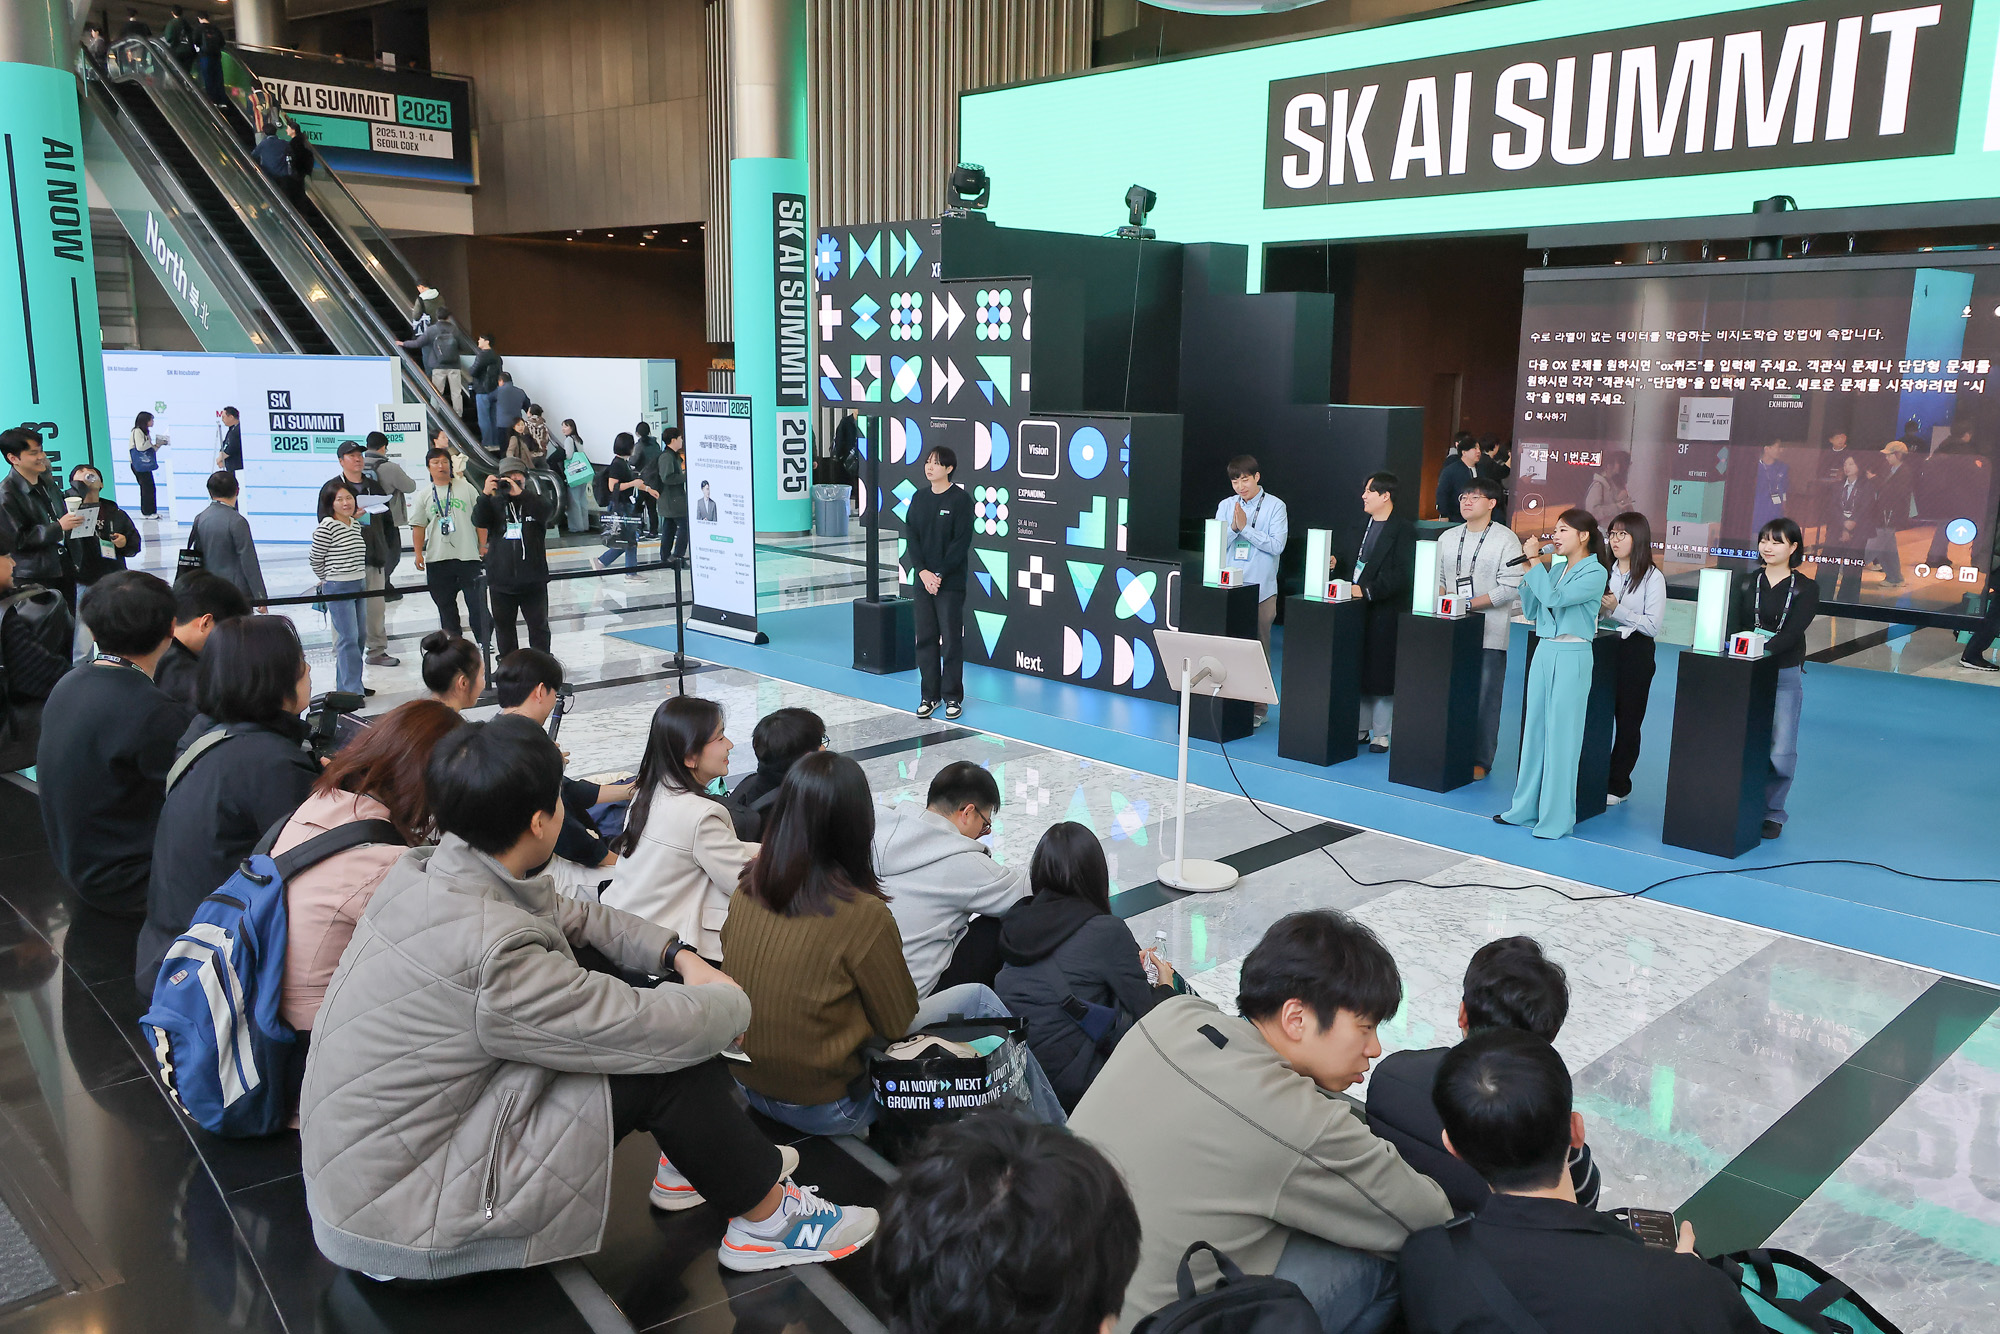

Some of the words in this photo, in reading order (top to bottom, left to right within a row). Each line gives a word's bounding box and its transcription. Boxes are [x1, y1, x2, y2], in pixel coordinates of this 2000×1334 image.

[263, 82, 288, 105] SK
[293, 86, 311, 107] AI
[315, 88, 390, 117] SUMMIT
[1281, 84, 1380, 190] SK
[1389, 72, 1474, 181] AI
[1491, 5, 1942, 171] SUMMIT
[402, 100, 447, 125] 2025
[376, 127, 398, 138] 2025.
[376, 139, 399, 149] SEOUL
[400, 141, 419, 151] COEX
[42, 136, 76, 172] AI
[47, 178, 85, 263] NOW
[778, 200, 804, 239] SK
[145, 210, 188, 300] North
[779, 245, 804, 273] AI
[189, 281, 200, 317] 북
[780, 280, 807, 399] SUMMIT
[1530, 332, 1551, 343] 수로
[1591, 331, 1612, 343] 없는
[1616, 331, 1661, 342] 데이터를
[1665, 330, 1712, 342] 학습하는
[1717, 329, 1778, 342] 비지도학습
[1783, 329, 1821, 341] 방법에
[1826, 328, 1885, 341] 속합니다.
[1528, 359, 1548, 371] 다음
[1552, 360, 1567, 371] OX
[1571, 359, 1602, 372] 문제를
[1606, 359, 1651, 372] 원하시면
[1719, 359, 1756, 372] 입력해
[1760, 359, 1802, 373] 주세요.
[1806, 360, 1847, 373] 객관식
[1851, 360, 1893, 373] 문제나
[1898, 360, 1941, 374] 단답형
[1946, 360, 1991, 374] 문제를
[1527, 375, 1569, 387] 원하시면
[1572, 376, 1594, 388] 각각
[1709, 377, 1746, 390] 입력해
[1750, 377, 1792, 391] 주세요.
[1796, 378, 1835, 391] 새로운
[1840, 378, 1881, 392] 문제를
[1886, 379, 1958, 393] 시작하려면
[270, 393, 288, 408] SK
[1555, 392, 1586, 404] 입력해
[1589, 393, 1626, 405] 주세요.
[1768, 400, 1804, 409] EXHIBITION
[685, 400, 693, 411] SK
[695, 401, 700, 412] AI
[701, 401, 727, 413] SUMMIT
[731, 402, 749, 414] 2025
[273, 415, 286, 429] AI
[288, 415, 341, 430] SUMMIT
[1536, 412, 1568, 422] 복사하기
[393, 423, 419, 431] SUMMIT
[274, 436, 308, 451] 2025
[386, 434, 404, 442] 2025
[782, 419, 807, 493] 2025
[1029, 444, 1049, 456] Vision
[1678, 444, 1689, 454] 3F
[1529, 450, 1559, 462] 객관식
[1563, 451, 1601, 464] 1번문제
[1018, 488, 1046, 499] EXPANDING
[1673, 485, 1682, 495] 2F
[1672, 526, 1681, 536] 1F
[1744, 549, 1760, 558] 개인
[1016, 650, 1044, 673] Next.
[900, 1080, 909, 1092] AI
[911, 1080, 937, 1092] NOW
[955, 1078, 982, 1091] NEXT
[887, 1097, 930, 1109] GROWTH
[948, 1085, 1001, 1109] INNOVATIVE
[794, 1224, 823, 1247] N
